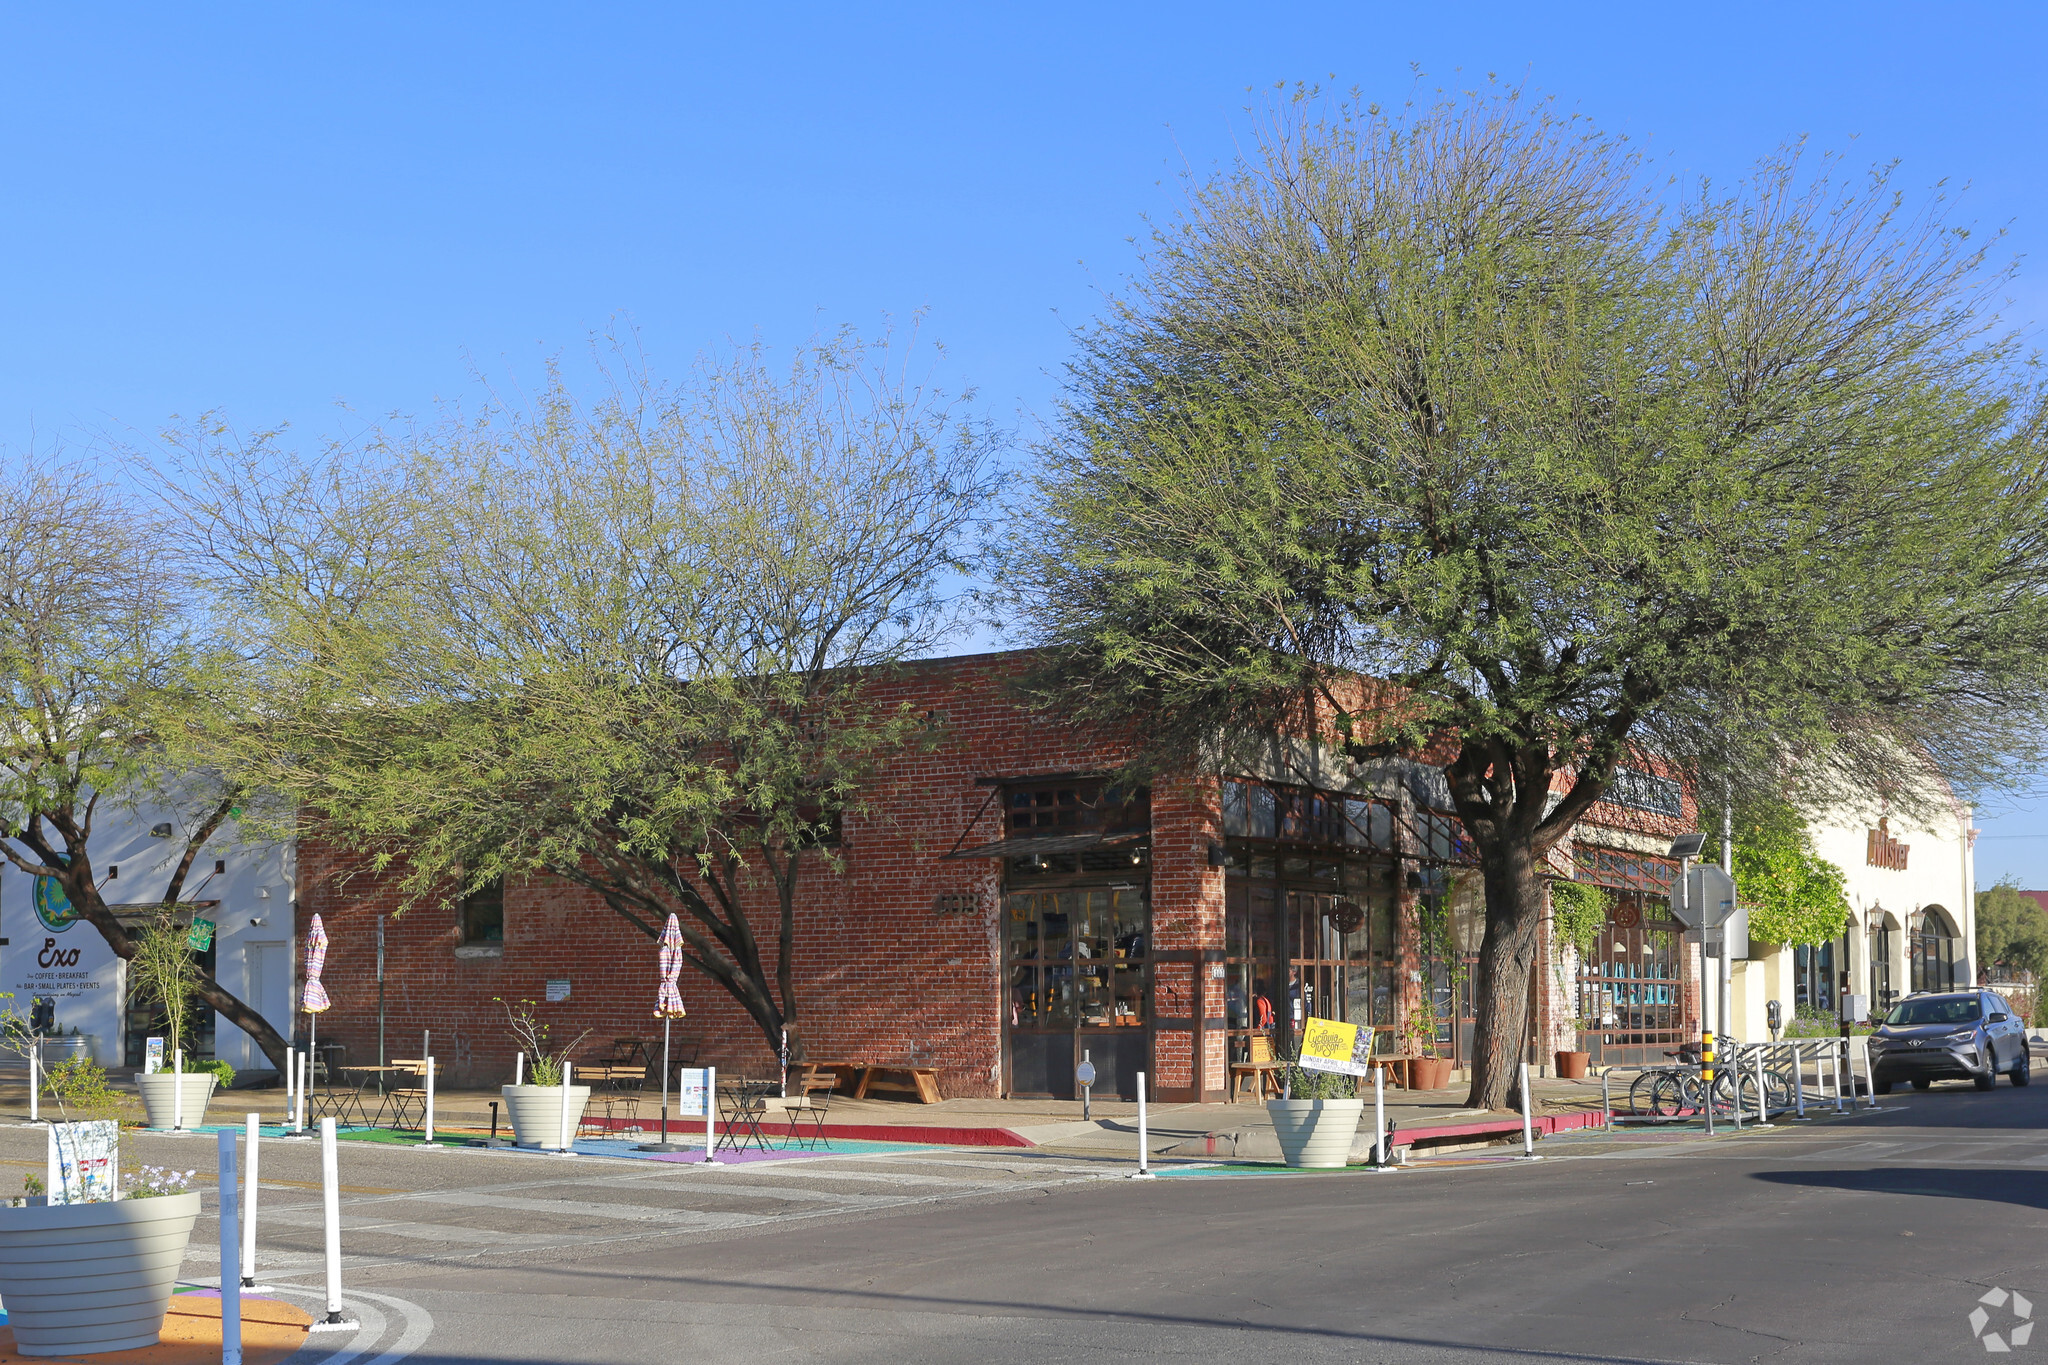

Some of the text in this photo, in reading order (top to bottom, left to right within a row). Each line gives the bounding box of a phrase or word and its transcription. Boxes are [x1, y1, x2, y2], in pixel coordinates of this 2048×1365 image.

[1870, 829, 1910, 870] Mister
[38, 937, 81, 969] Exo
[1308, 1028, 1343, 1044] Cyclovia
[1302, 1055, 1323, 1064] SUNDAY
